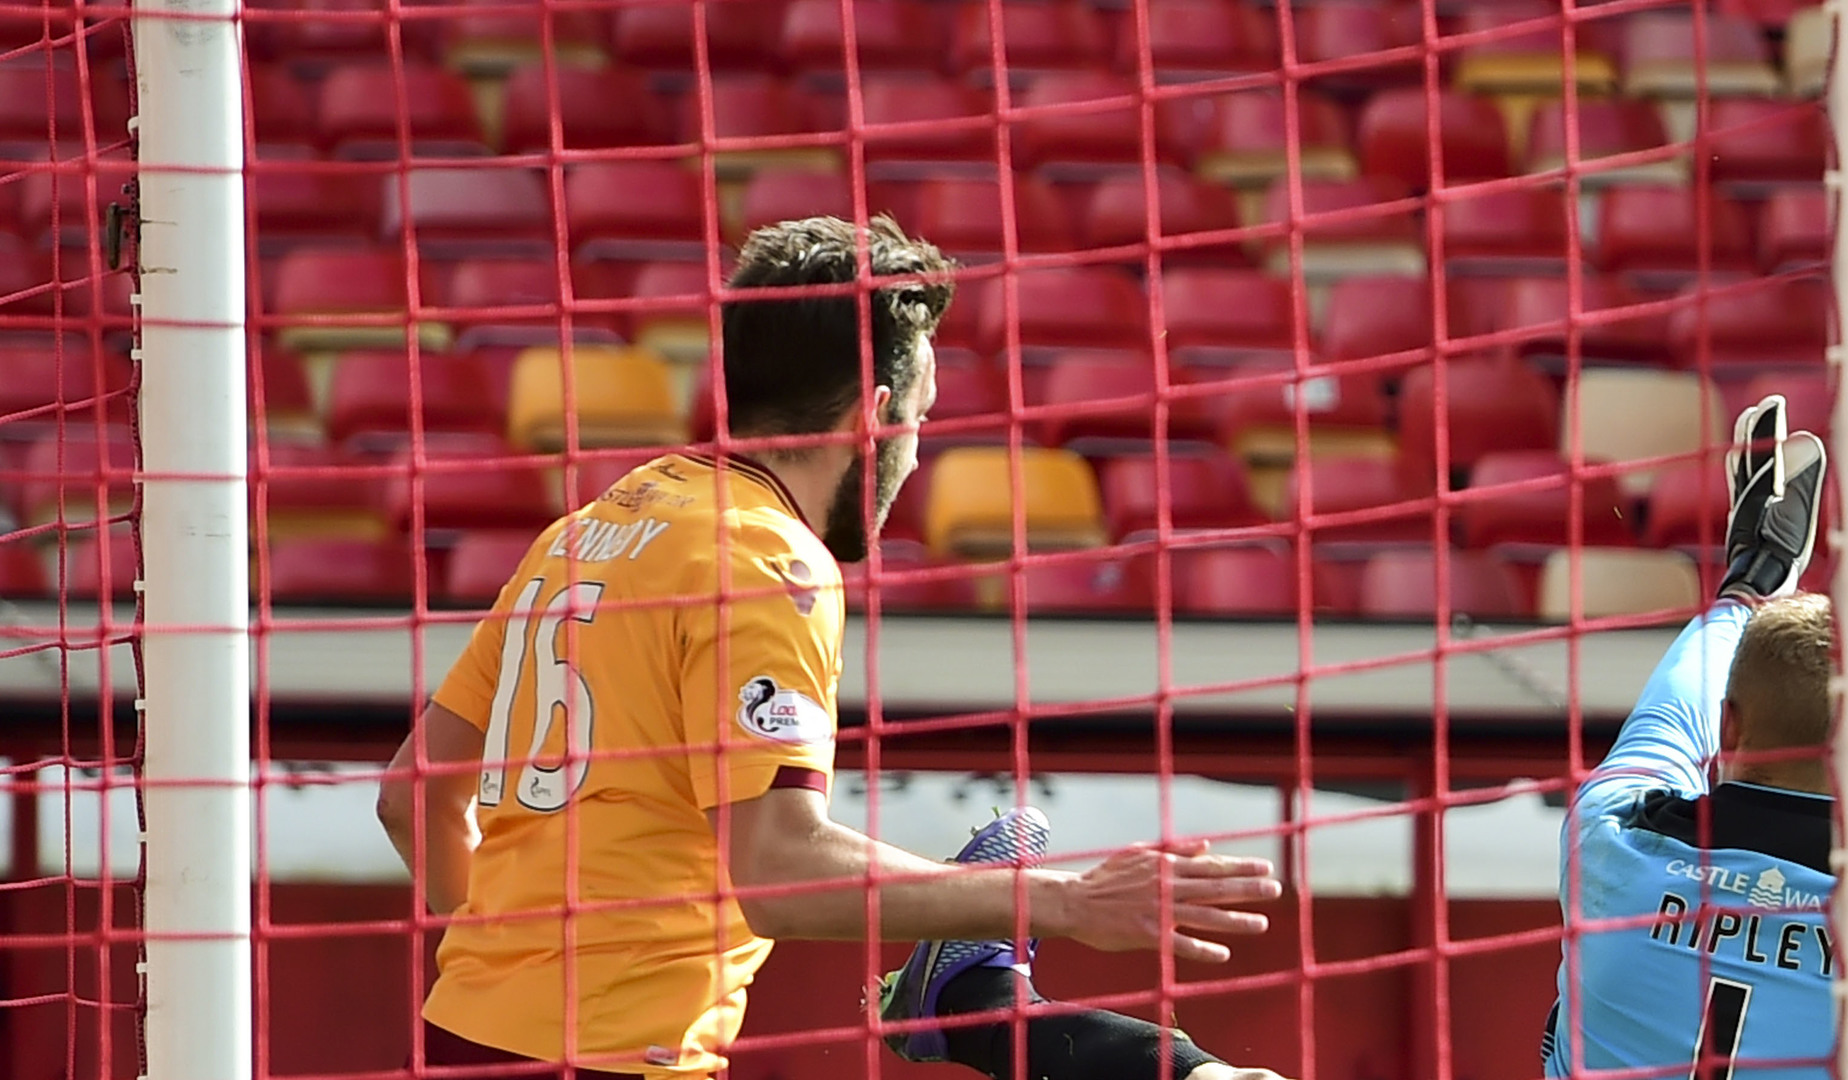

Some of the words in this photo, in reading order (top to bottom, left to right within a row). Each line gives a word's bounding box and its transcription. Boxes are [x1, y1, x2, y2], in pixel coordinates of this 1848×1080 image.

[477, 577, 606, 812] 16
[1665, 859, 1750, 895] CASTLE
[1650, 892, 1838, 978] RIPLEY
